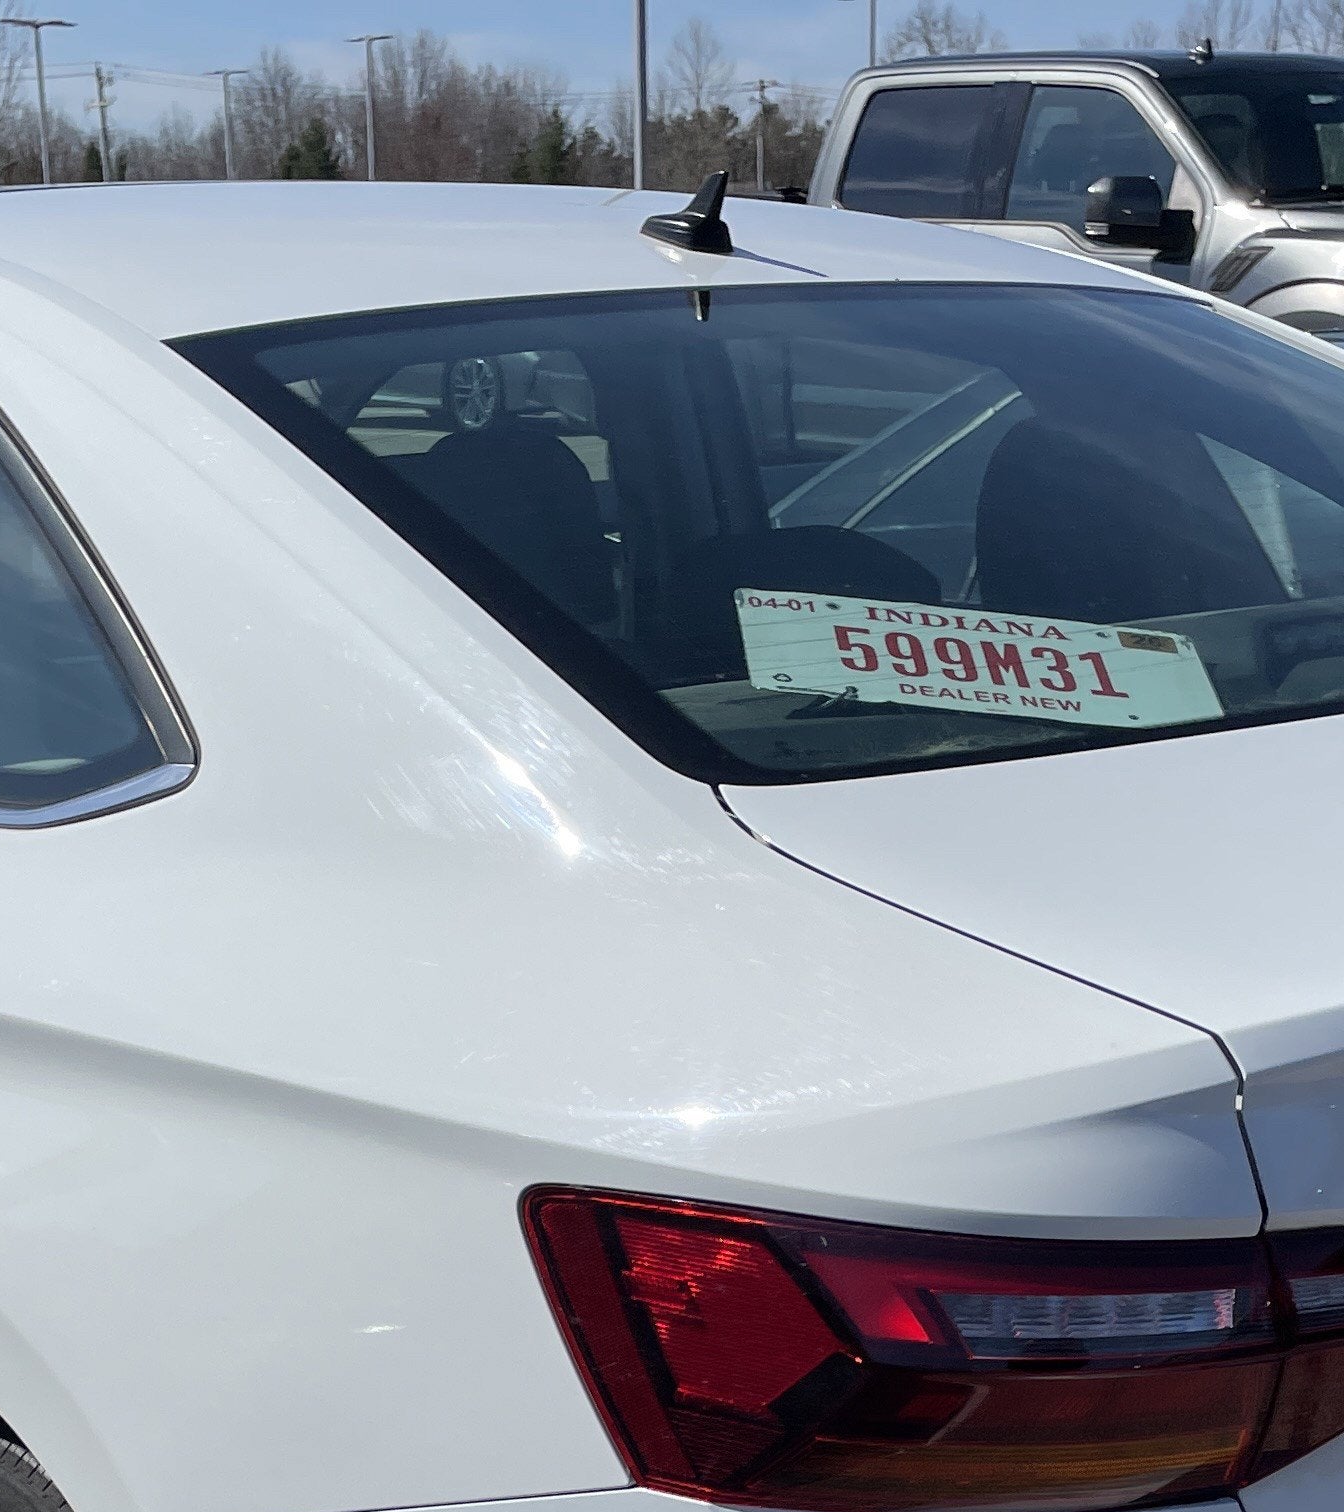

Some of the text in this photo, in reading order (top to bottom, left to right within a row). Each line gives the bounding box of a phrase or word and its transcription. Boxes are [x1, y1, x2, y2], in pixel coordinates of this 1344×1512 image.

[748, 596, 816, 613] 04-01
[864, 605, 1073, 641] INDIANA
[833, 624, 1130, 699] 599M31
[899, 682, 1082, 713] DEALER NEW
